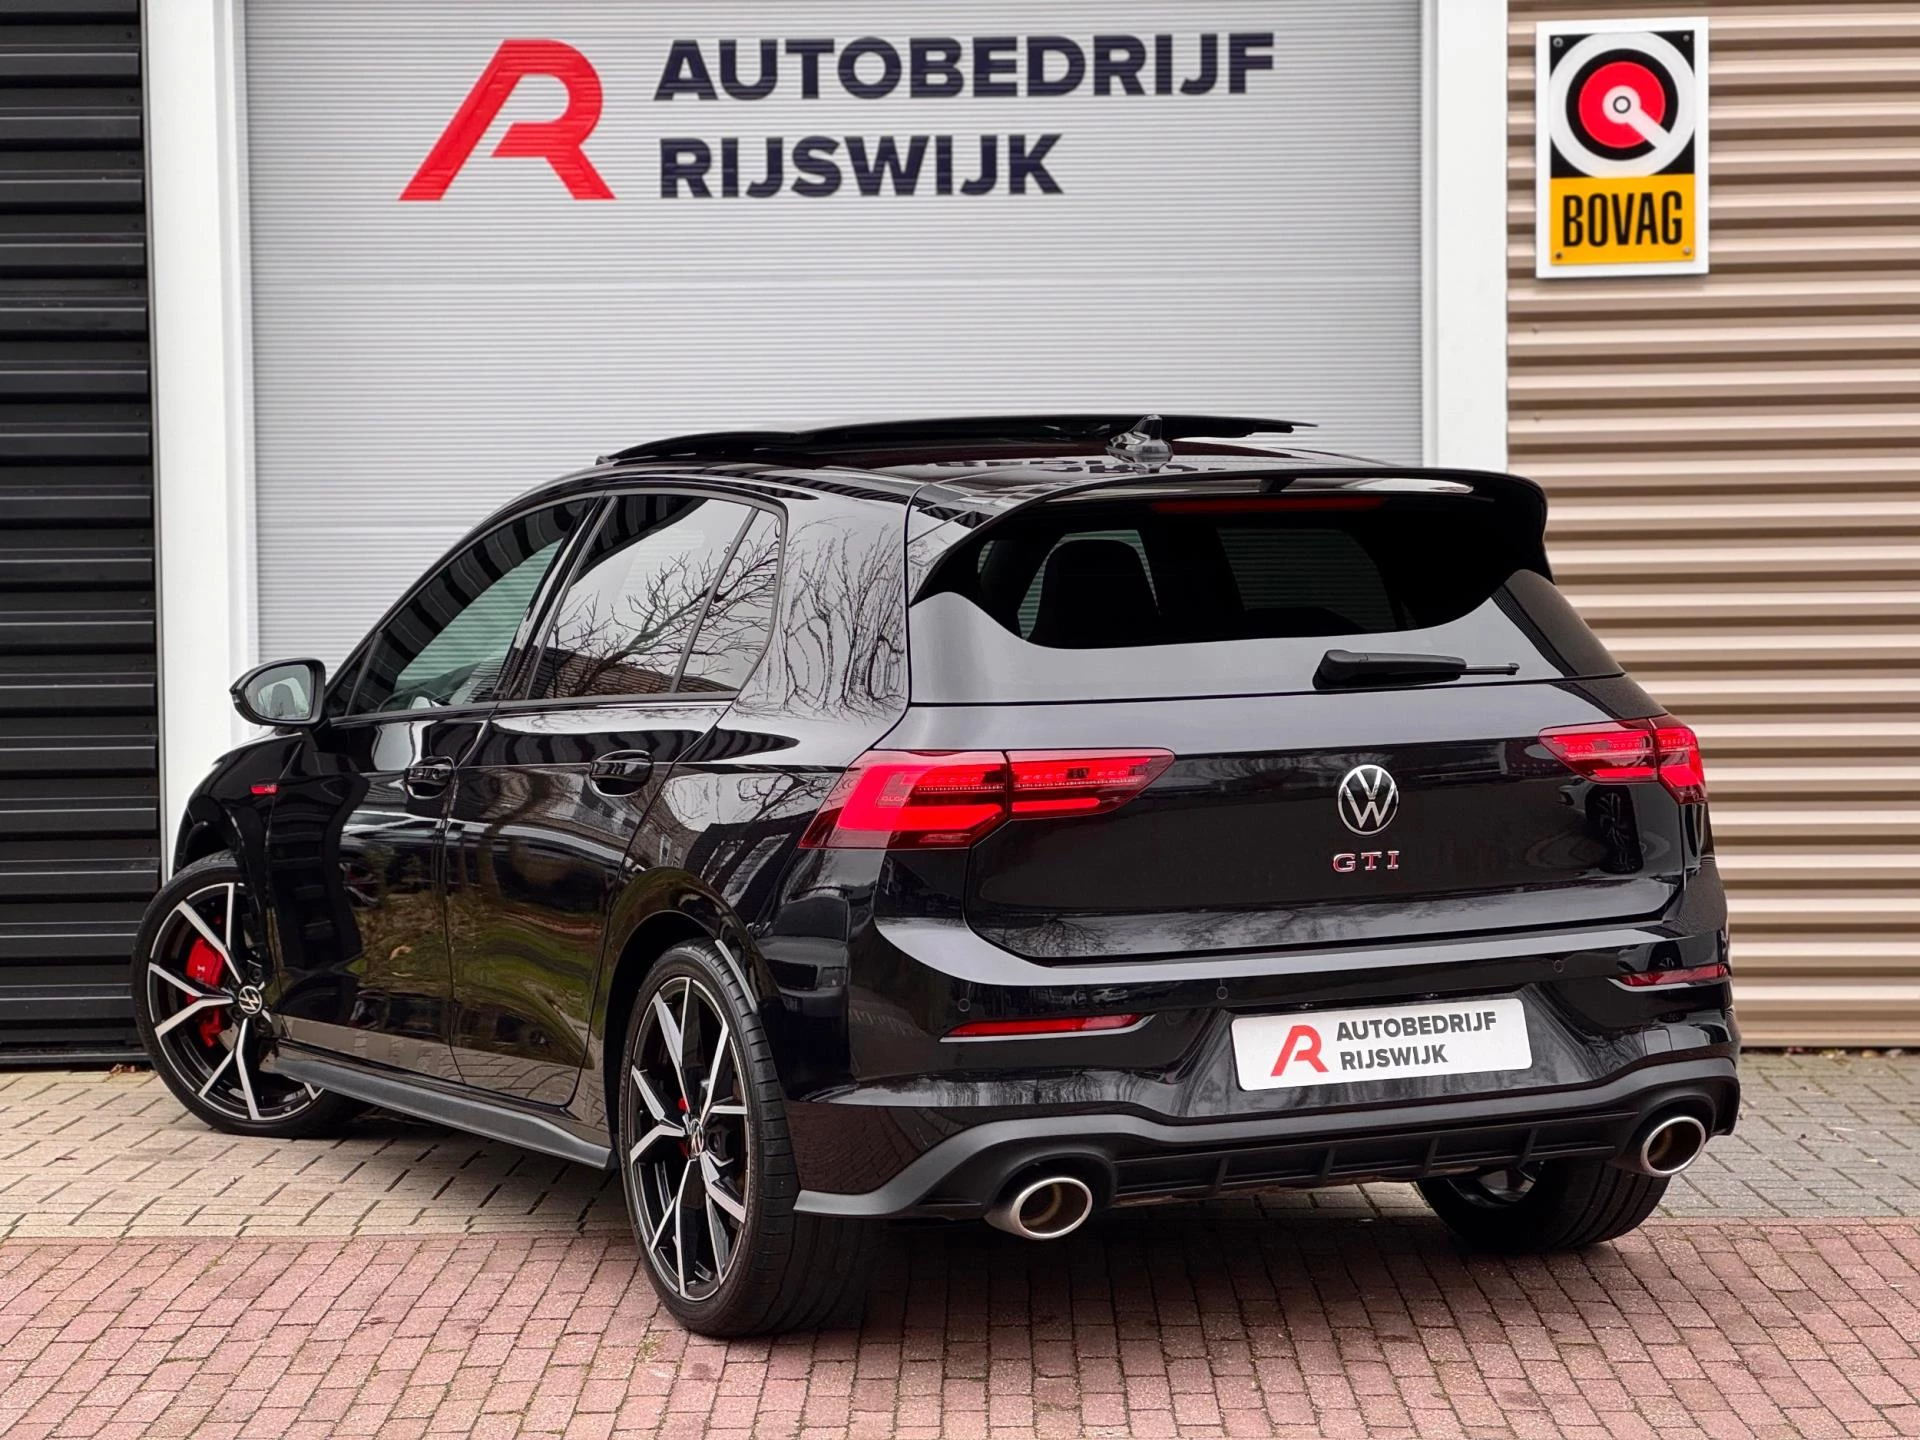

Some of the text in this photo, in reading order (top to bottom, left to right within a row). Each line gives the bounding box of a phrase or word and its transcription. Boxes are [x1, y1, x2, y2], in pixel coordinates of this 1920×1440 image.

[654, 32, 1275, 101] AUTOBEDRIJF
[660, 134, 1063, 199] RIJSWIJK
[1563, 190, 1683, 247] BOVAG
[1333, 850, 1400, 872] GTI
[1336, 1011, 1497, 1042] AUTOBEDRIJF
[1339, 1044, 1448, 1070] RIJSWIJK
